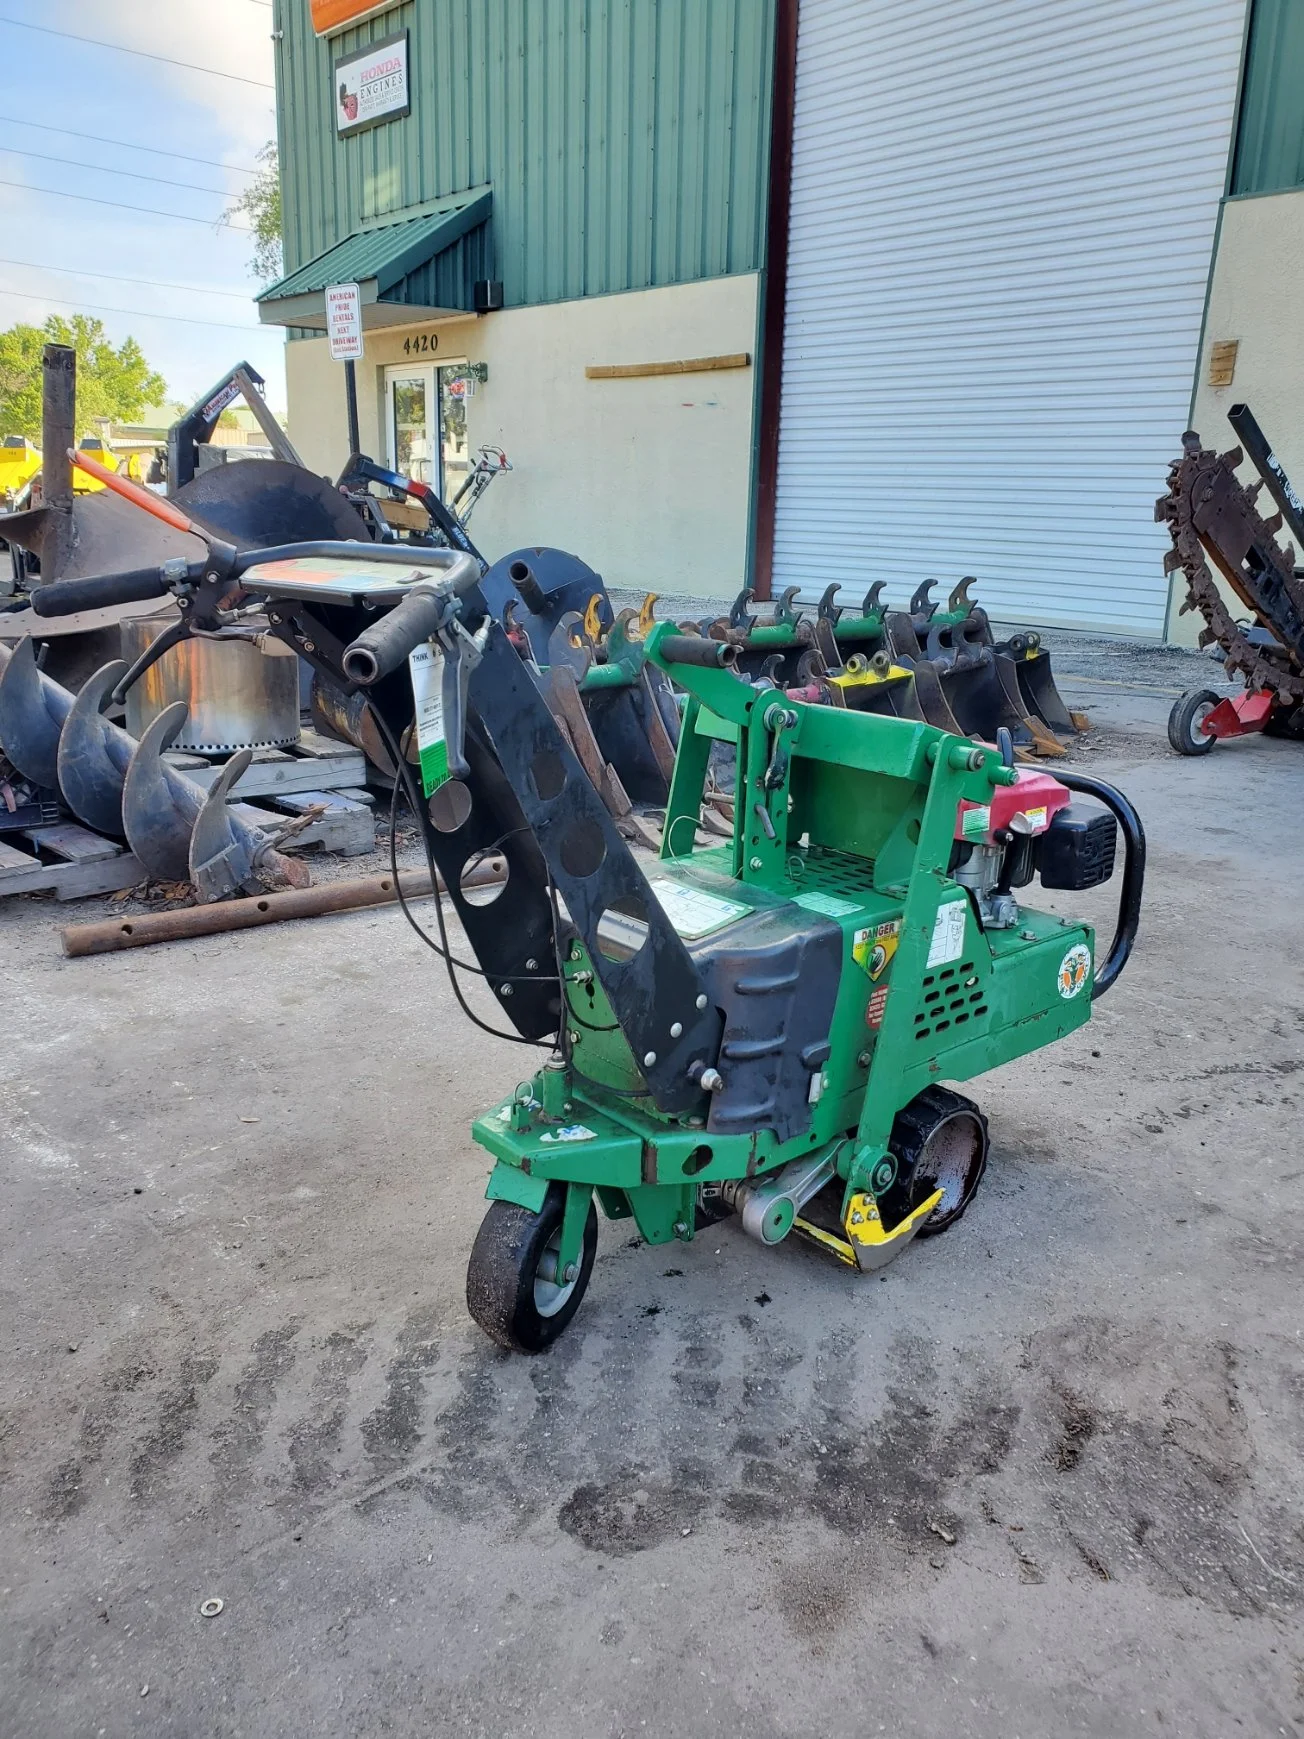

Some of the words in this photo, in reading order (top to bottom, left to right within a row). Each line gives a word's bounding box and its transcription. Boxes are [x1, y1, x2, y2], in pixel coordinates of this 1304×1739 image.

[360, 58, 402, 82] HONDA
[360, 73, 403, 99] ENGINES
[329, 291, 356, 301] AMERICAN
[332, 313, 354, 323] RENTALS
[332, 336, 358, 346] DRIVEWAY
[403, 334, 438, 355] 4420
[412, 652, 428, 663] THINK
[861, 923, 895, 941] DANGER
